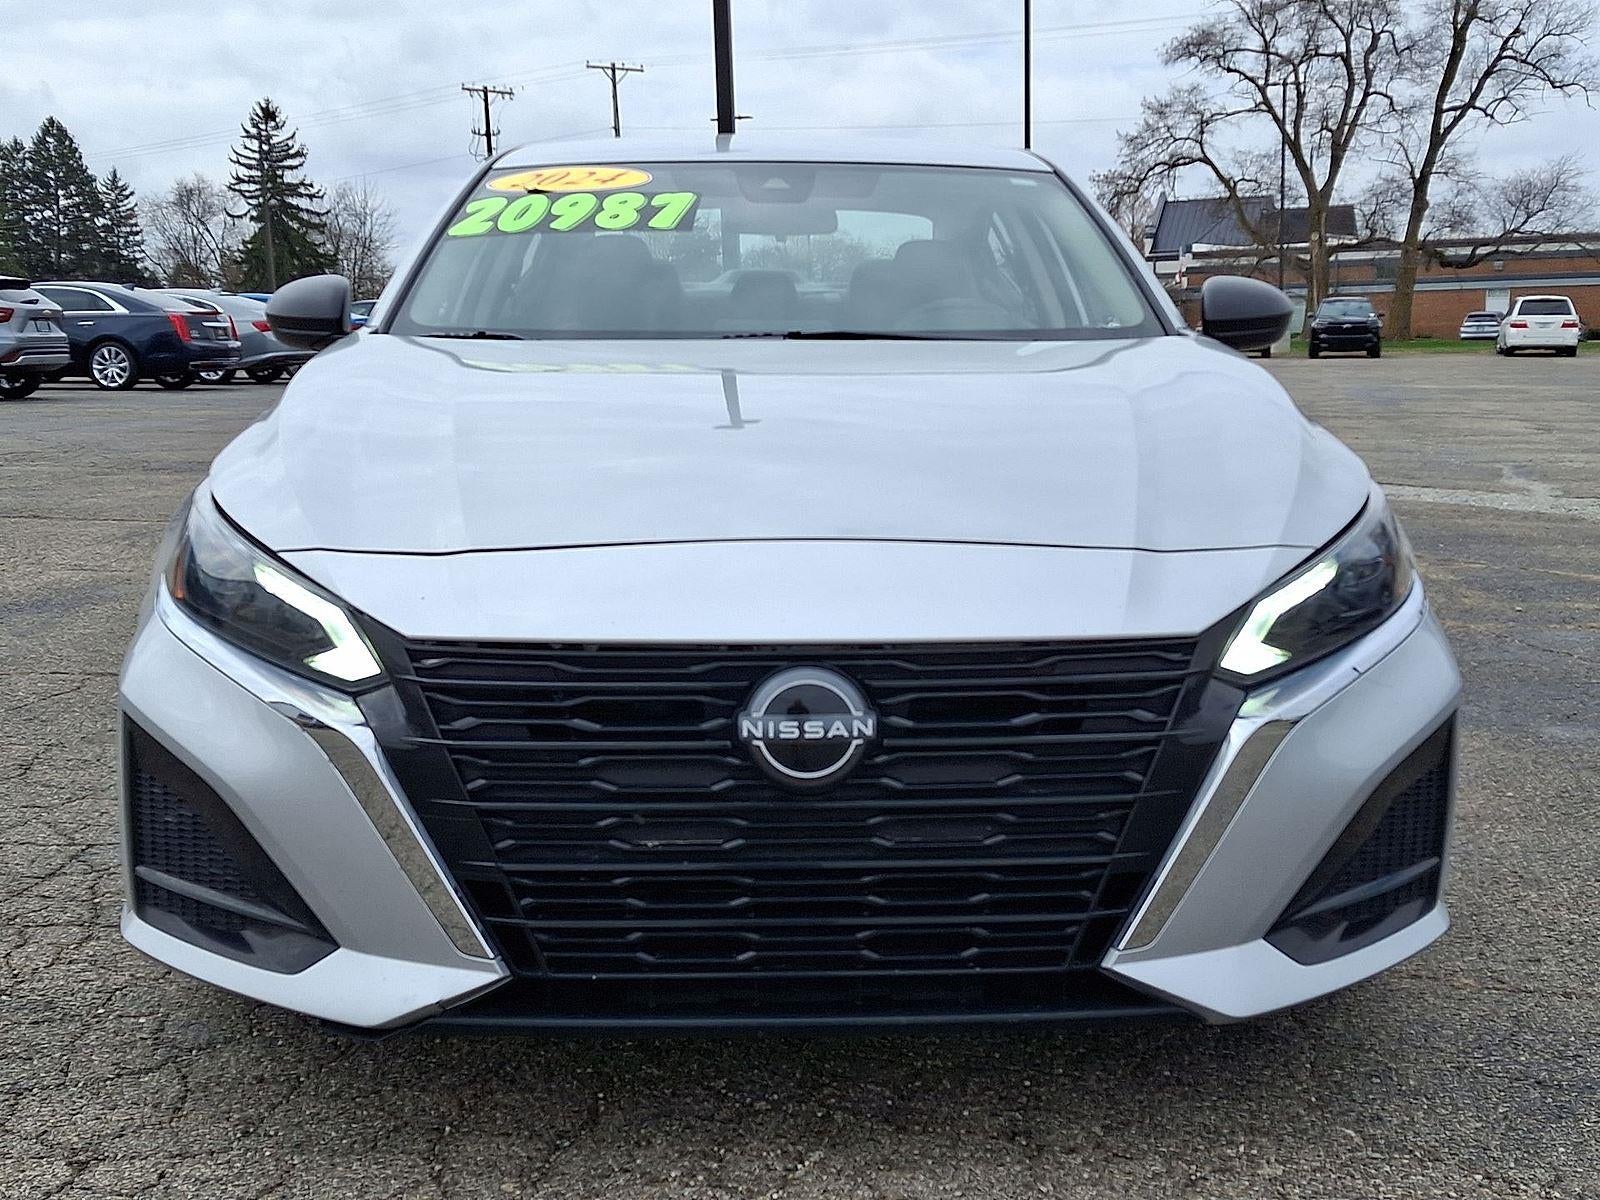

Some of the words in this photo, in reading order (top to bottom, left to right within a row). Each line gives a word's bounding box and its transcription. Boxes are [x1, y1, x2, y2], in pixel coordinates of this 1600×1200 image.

[506, 168, 629, 190] 2024
[448, 192, 697, 236] 20987
[741, 719, 873, 739] NISSAN
